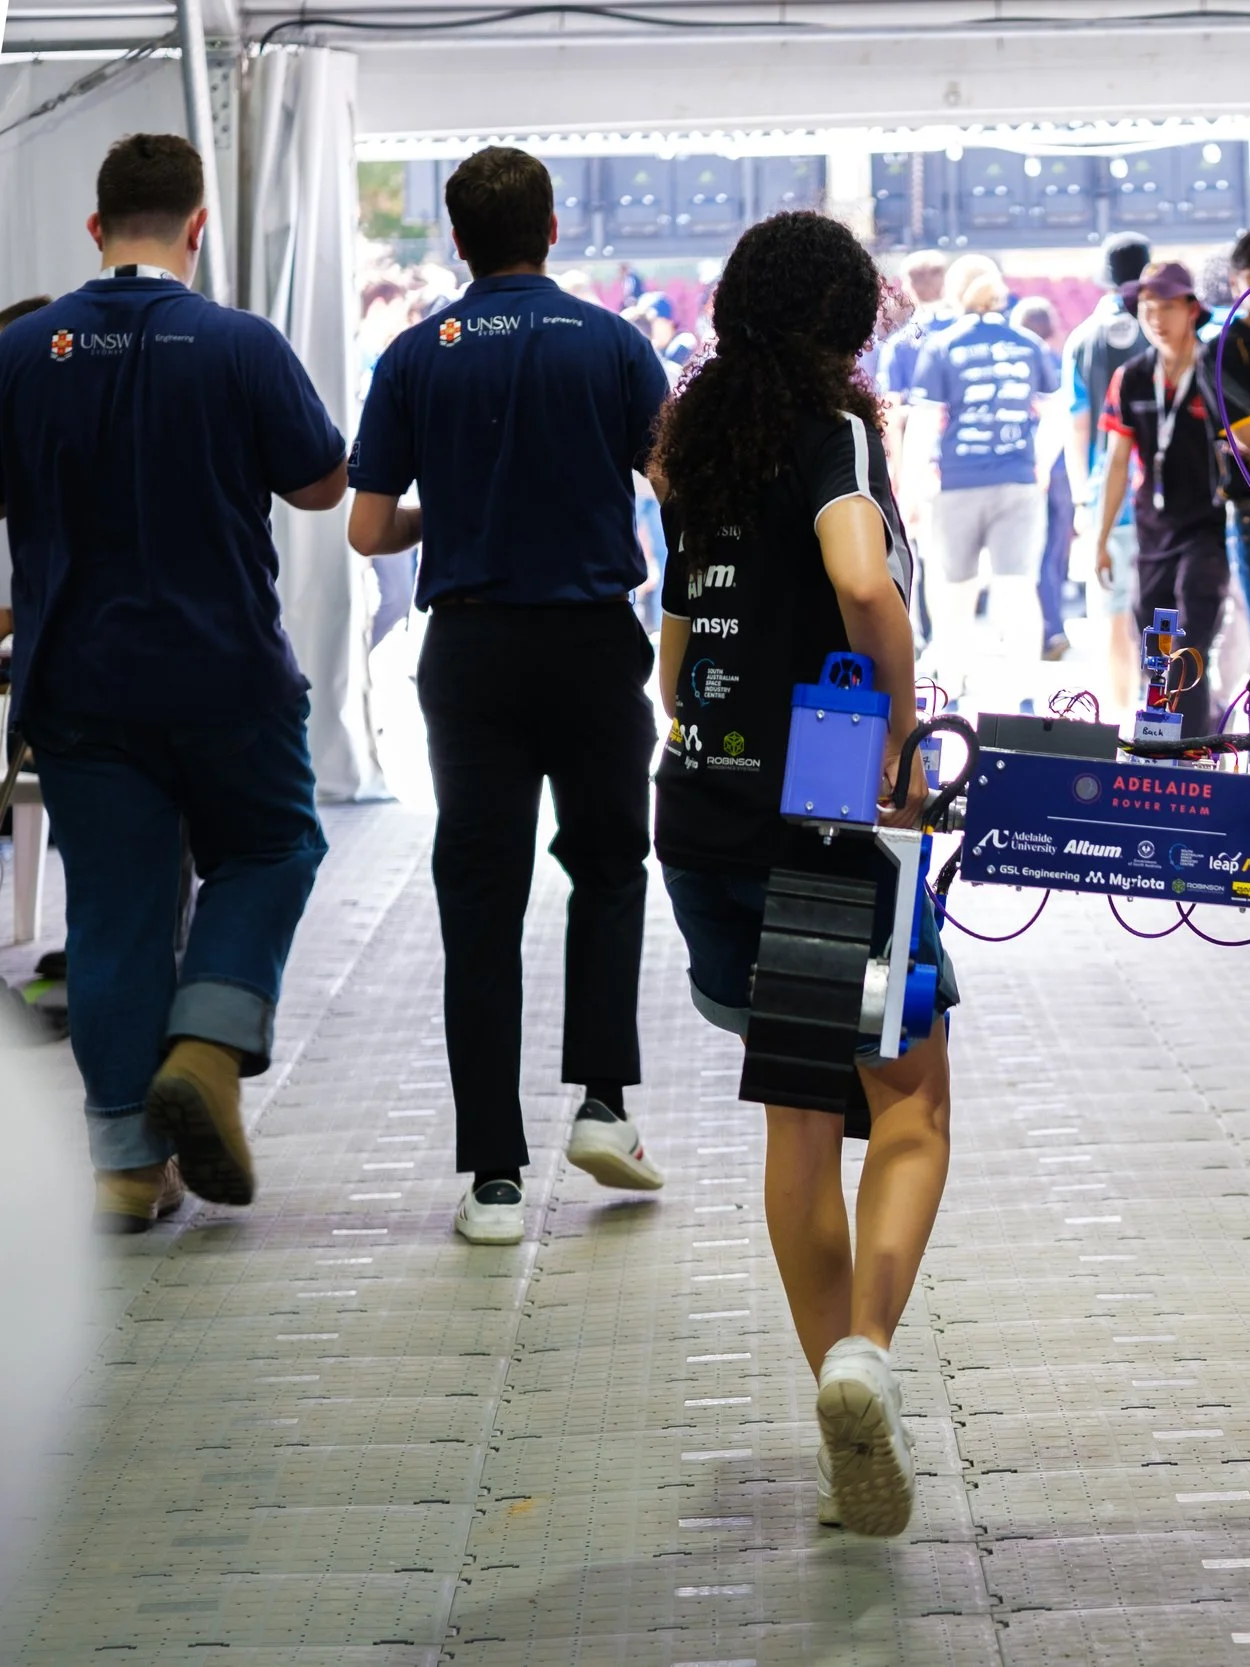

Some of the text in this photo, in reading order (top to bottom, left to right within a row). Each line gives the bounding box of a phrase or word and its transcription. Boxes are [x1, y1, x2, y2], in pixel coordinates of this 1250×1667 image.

[467, 315, 583, 332] UNSW Engineering
[80, 332, 195, 349] UNSW Engineering
[477, 329, 512, 337] SYDNEY
[706, 674, 740, 682] AUSTRALIAN
[1142, 726, 1164, 737] Back
[706, 756, 761, 767] ROBINSON
[1112, 775, 1213, 798] ADELAIDE
[1112, 798, 1211, 816] ROVER TEAM
[1011, 831, 1053, 843] Adelaide
[1011, 841, 1057, 855] University
[1063, 839, 1122, 858] Altium
[999, 865, 1080, 882] GSL Engineering
[1209, 856, 1240, 874] leap
[1109, 873, 1165, 890] Myriota
[1186, 882, 1225, 892] ROBINSON
